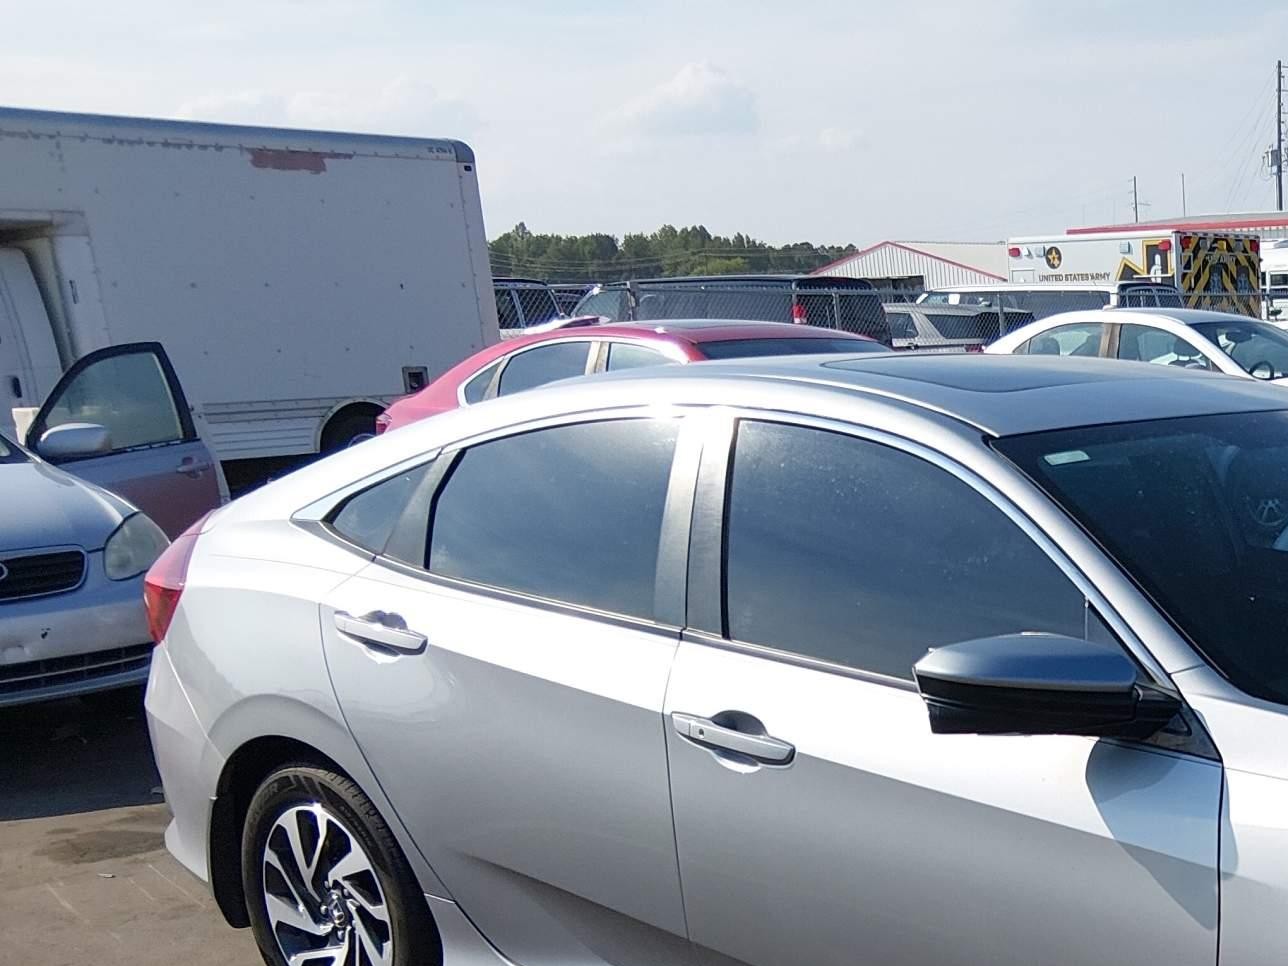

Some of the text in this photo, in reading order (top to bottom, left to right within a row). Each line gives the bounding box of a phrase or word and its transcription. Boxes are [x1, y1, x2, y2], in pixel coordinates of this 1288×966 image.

[1038, 272, 1110, 282] UNITED STATES ARMY
